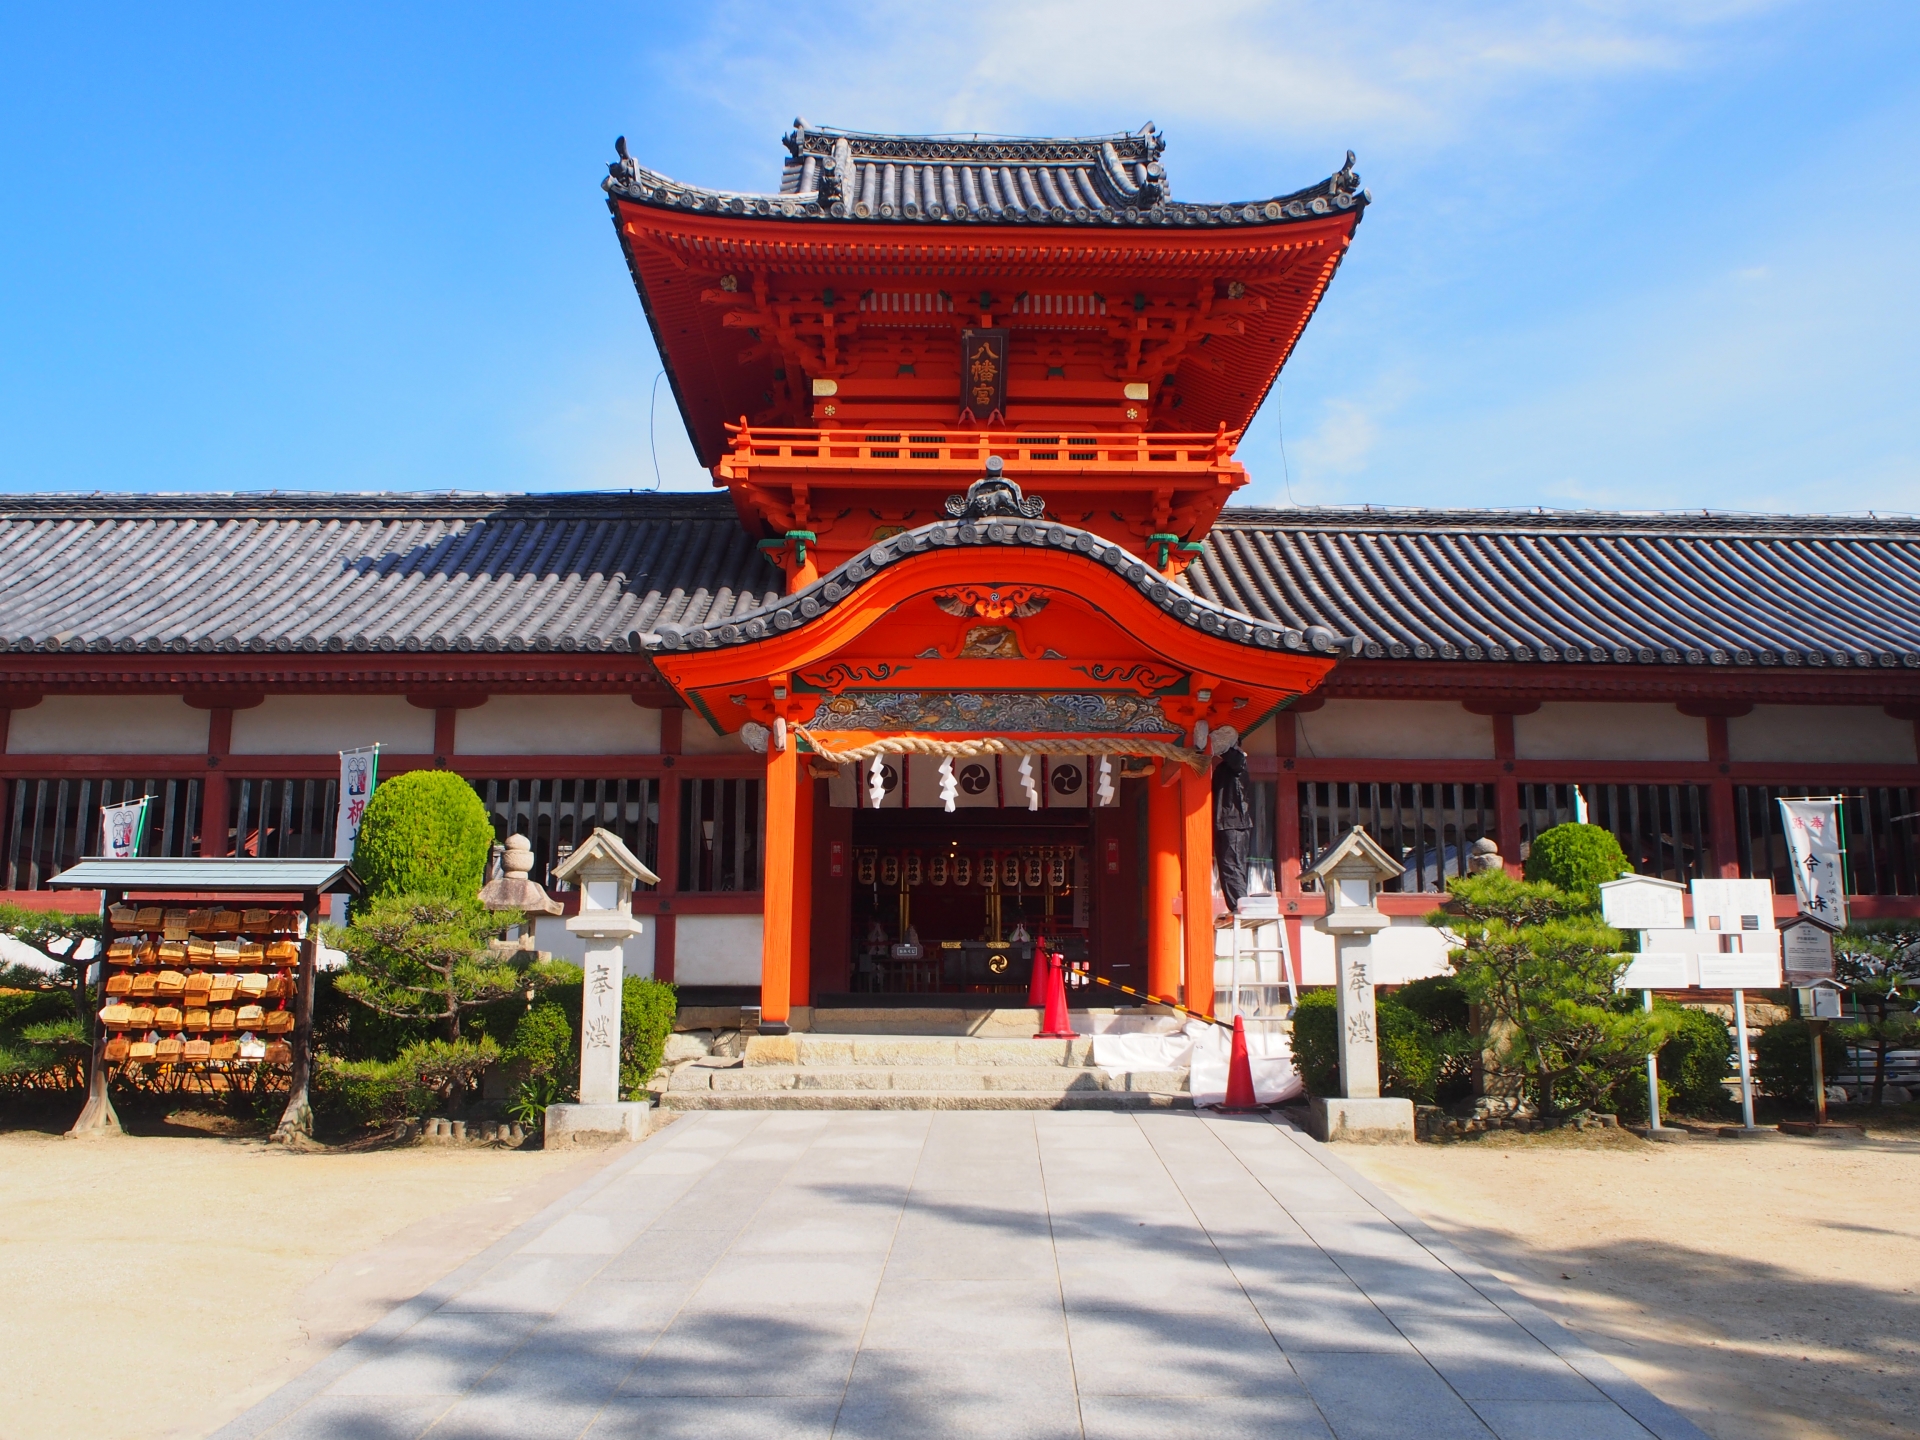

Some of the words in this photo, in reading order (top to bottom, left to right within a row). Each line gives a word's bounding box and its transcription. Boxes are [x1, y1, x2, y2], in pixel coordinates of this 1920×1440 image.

[970, 342, 999, 405] 八幡宮
[832, 845, 841, 873] 禁煙
[1108, 843, 1117, 871] 禁煙
